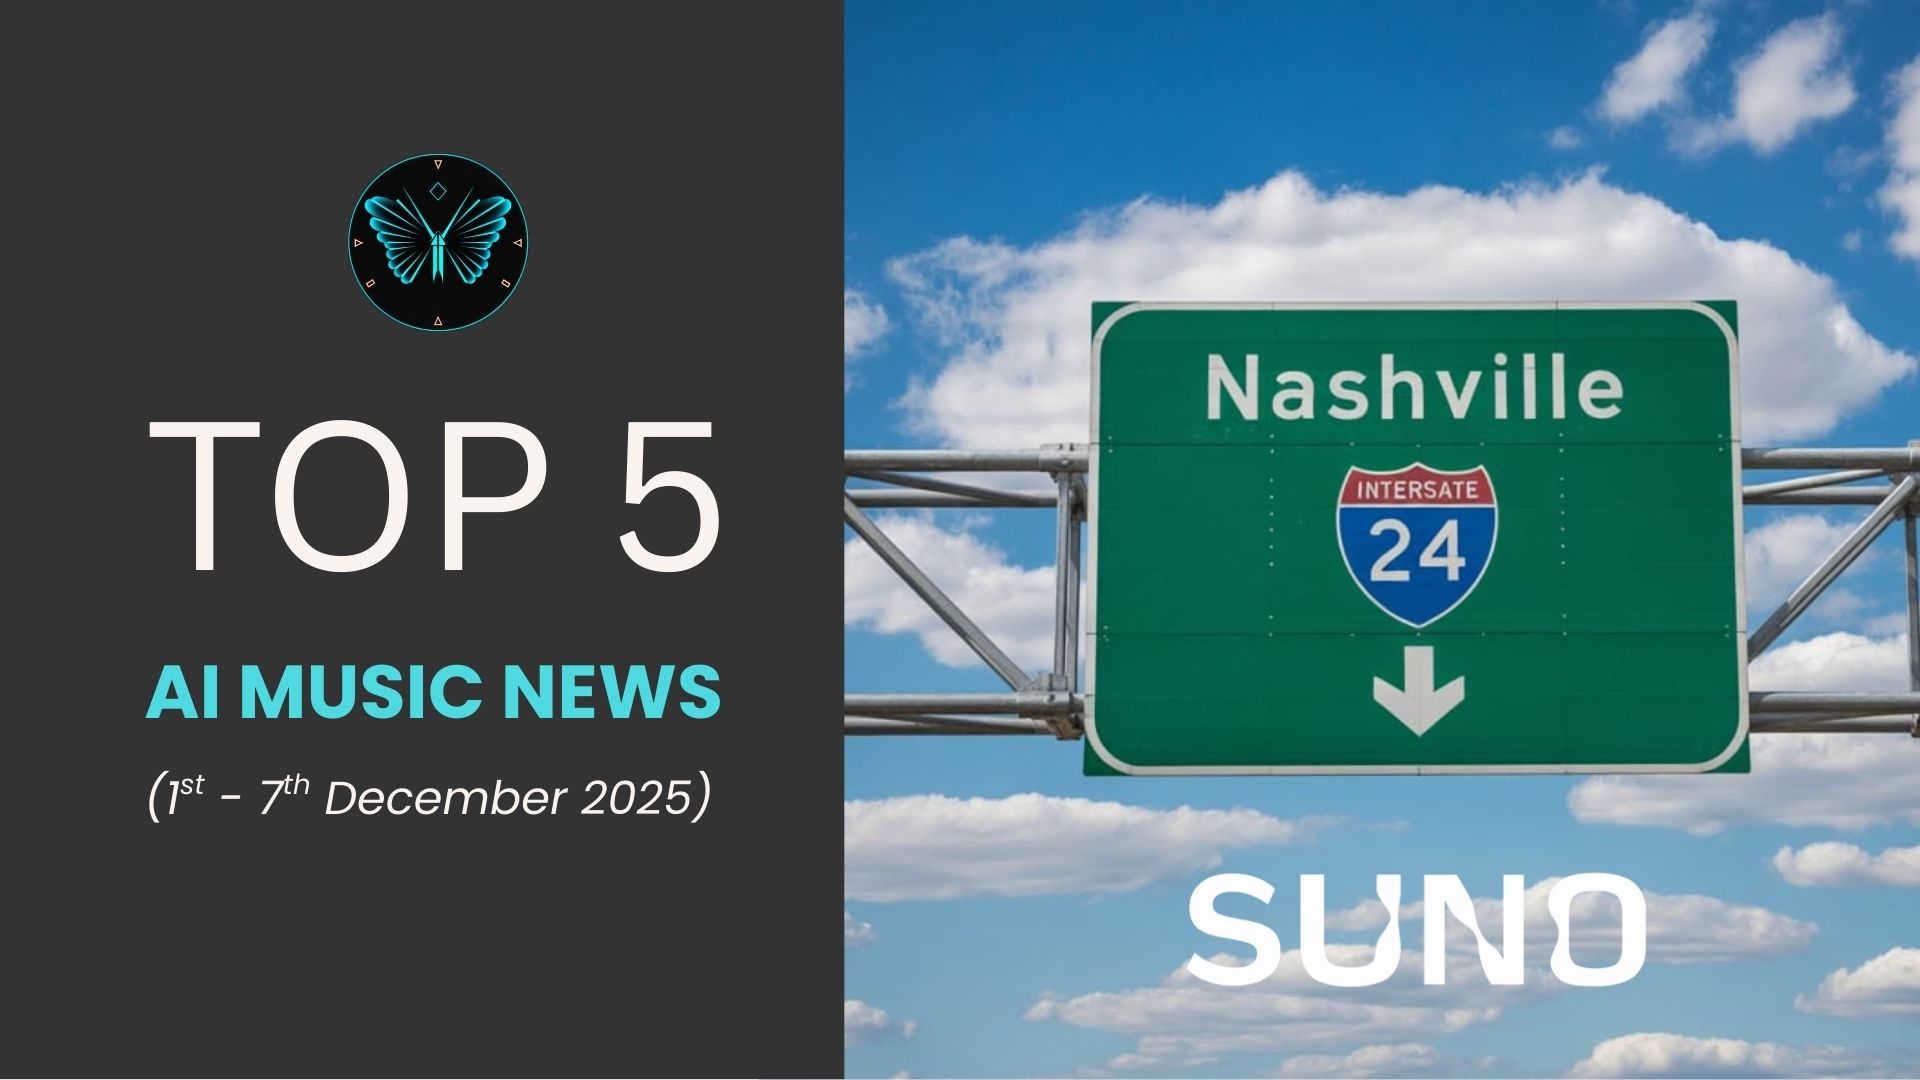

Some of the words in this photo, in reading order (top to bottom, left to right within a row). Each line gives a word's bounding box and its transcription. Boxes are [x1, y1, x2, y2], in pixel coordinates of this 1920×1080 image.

[1207, 352, 1624, 421] Nashville
[1357, 480, 1480, 500] INTERSATE
[1369, 517, 1467, 583] 24
